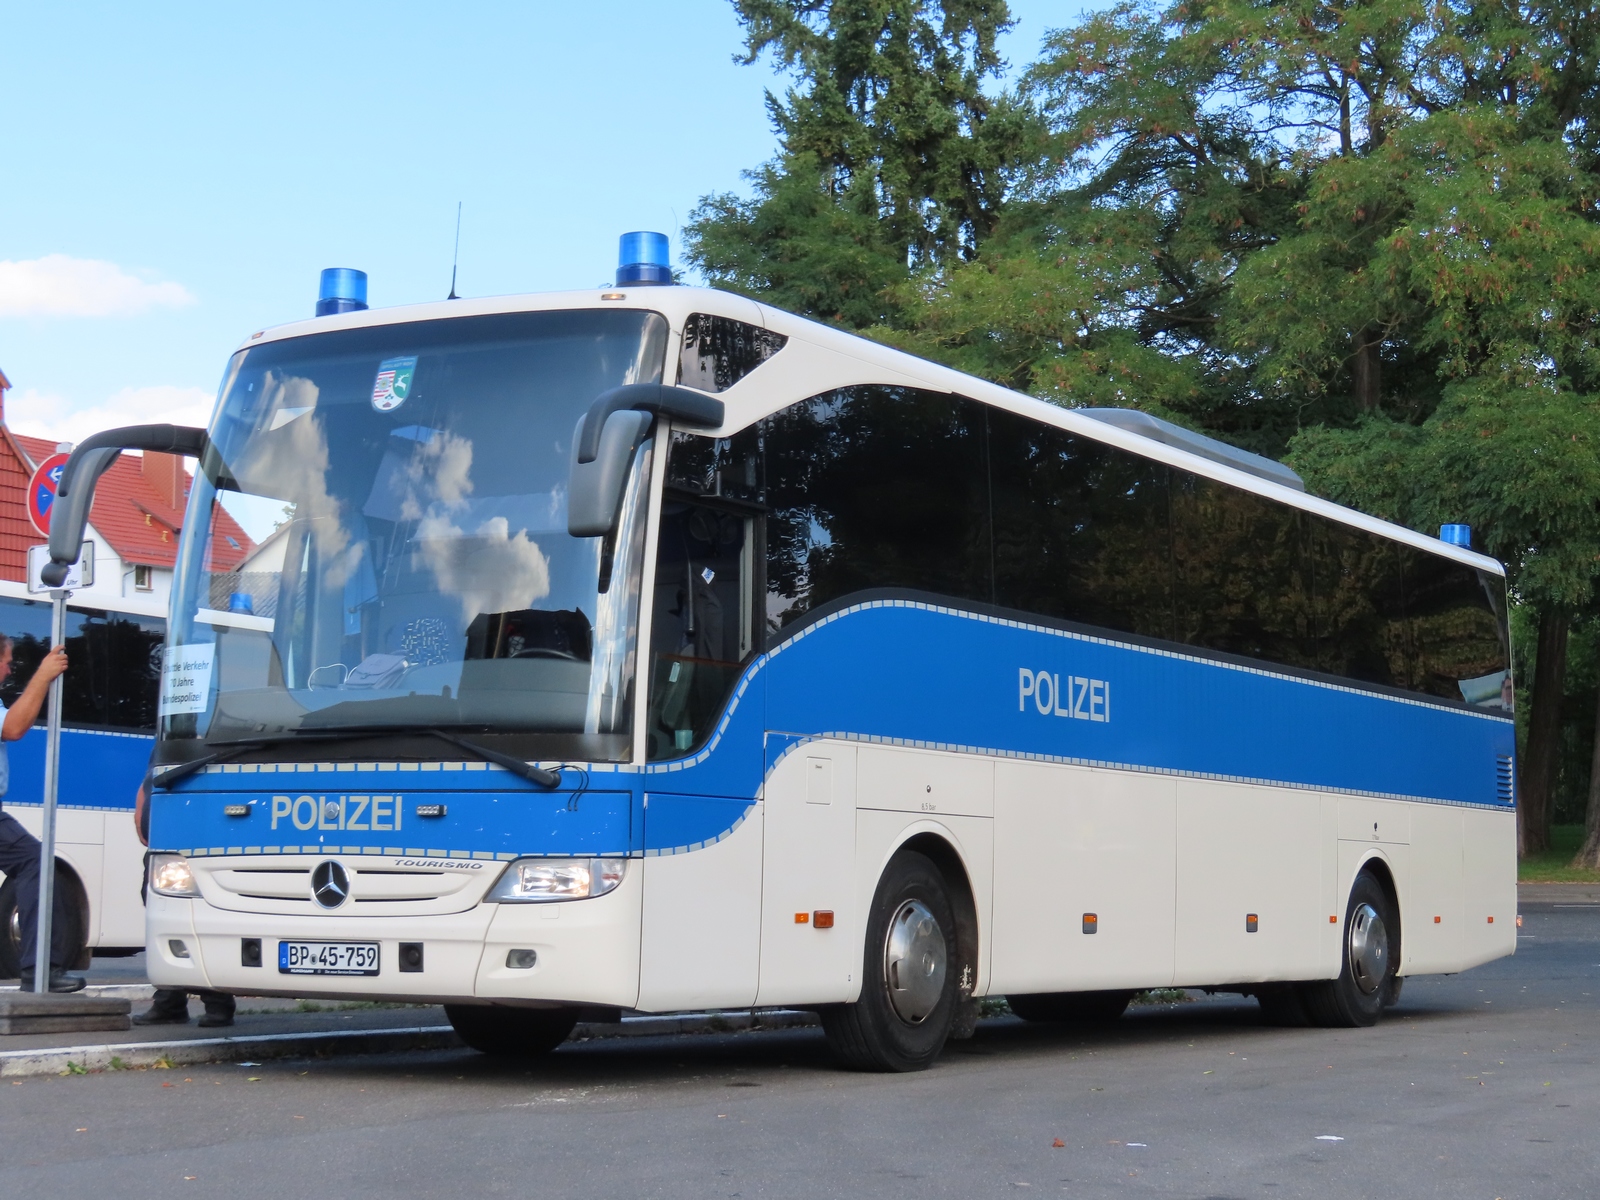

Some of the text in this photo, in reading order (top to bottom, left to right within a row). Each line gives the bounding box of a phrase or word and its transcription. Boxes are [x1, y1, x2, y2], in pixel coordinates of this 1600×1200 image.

[183, 660, 210, 671] Verkehr
[177, 677, 195, 688] Jahre
[1019, 667, 1110, 723] POLIZEI
[271, 795, 402, 831] POLIZEI
[395, 859, 483, 870] TOURISMO
[289, 946, 377, 967] BP 45-759
